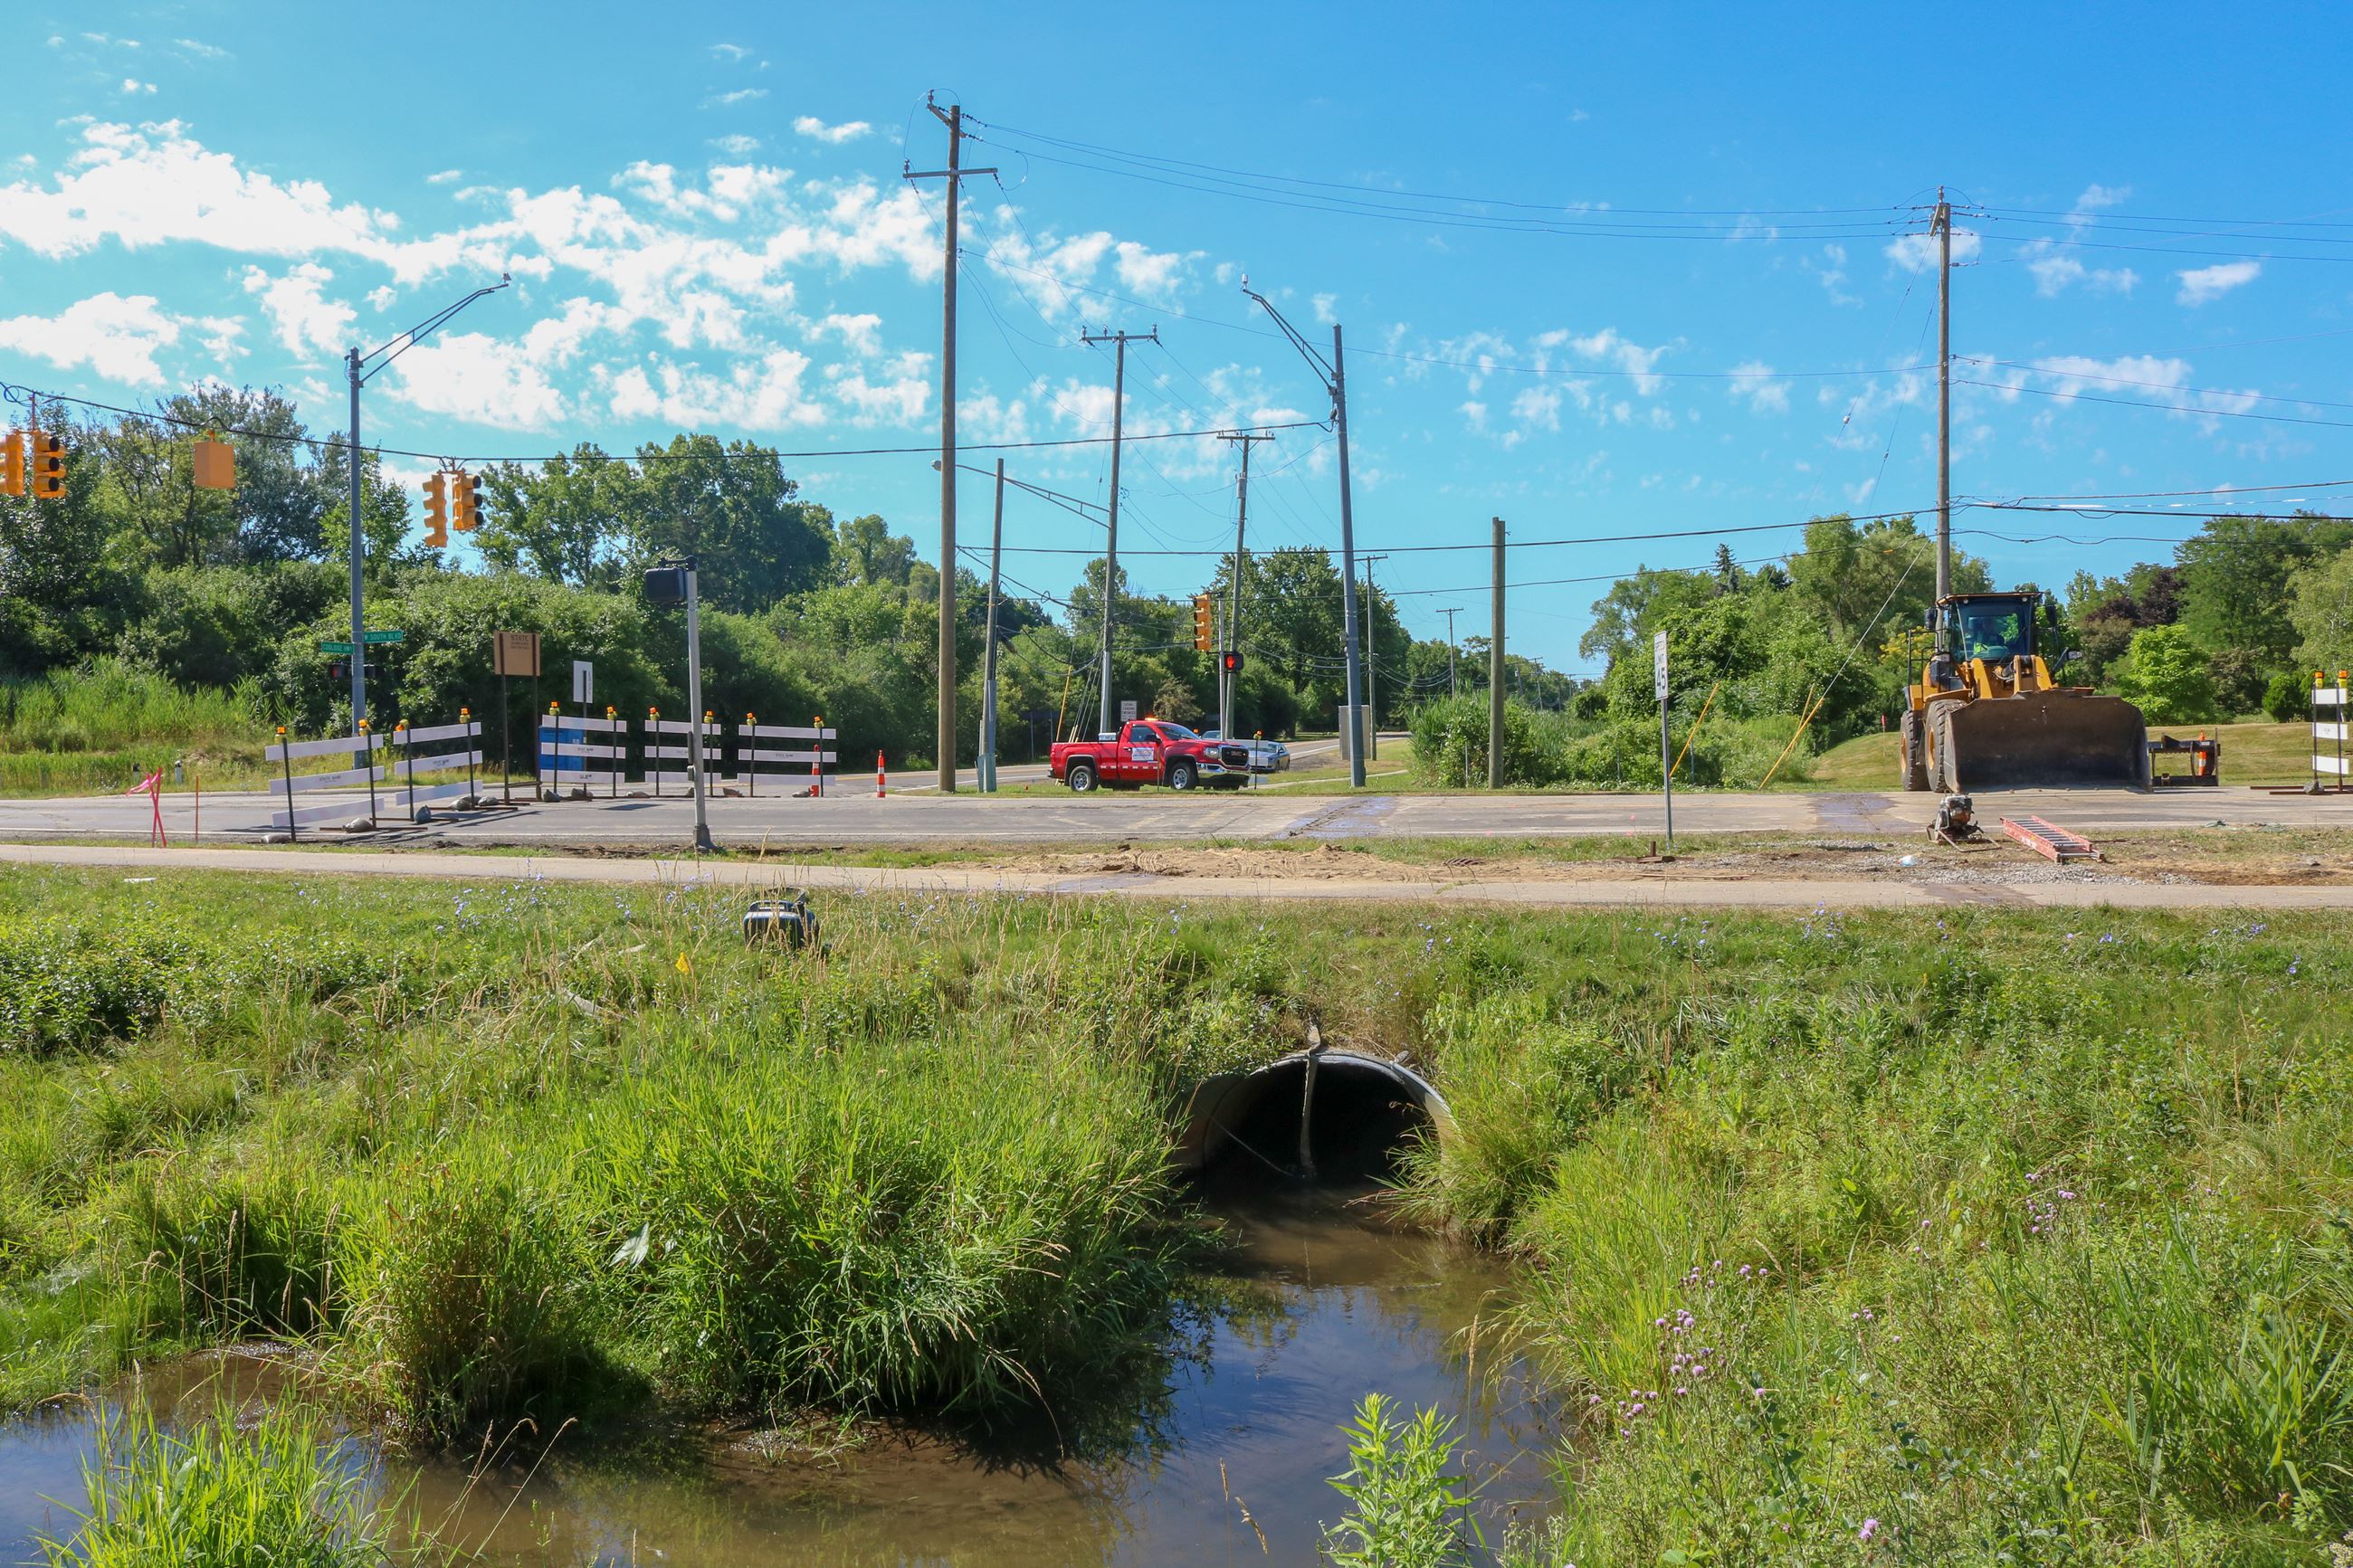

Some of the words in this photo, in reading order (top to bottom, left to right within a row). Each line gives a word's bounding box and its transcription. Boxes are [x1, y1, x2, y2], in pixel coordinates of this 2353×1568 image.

[370, 632, 386, 641] SOUTH
[388, 632, 403, 640] BLVD
[1656, 667, 1667, 691] 45
